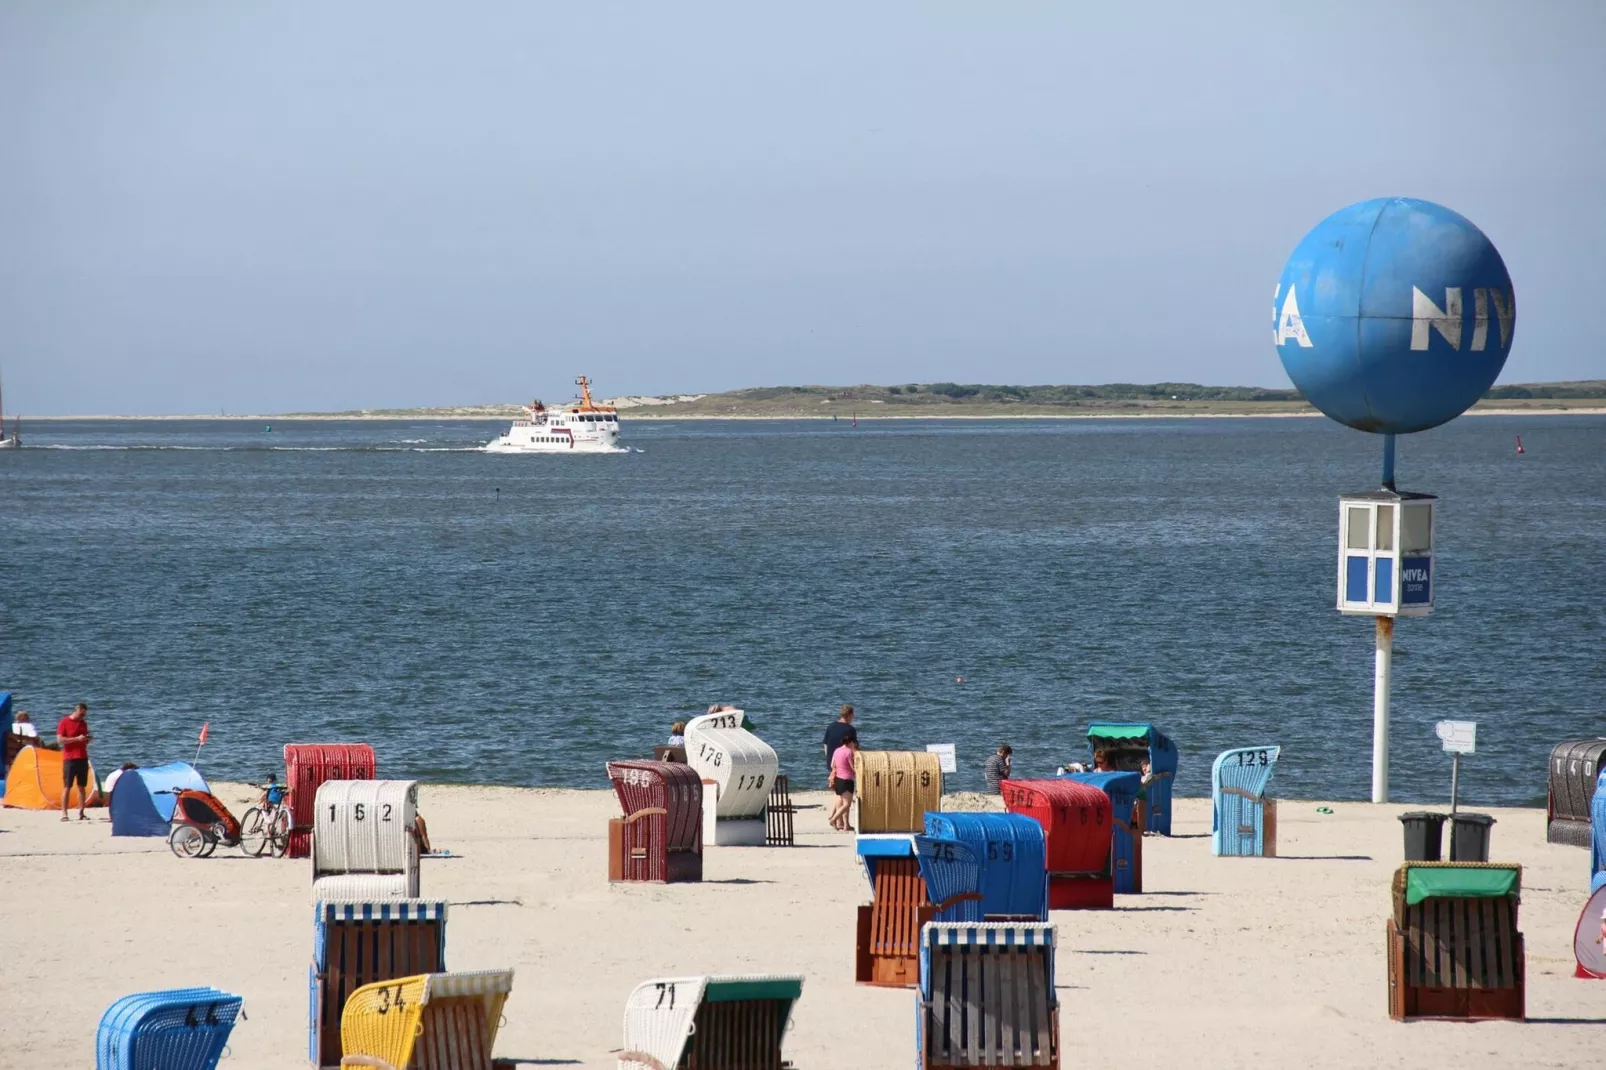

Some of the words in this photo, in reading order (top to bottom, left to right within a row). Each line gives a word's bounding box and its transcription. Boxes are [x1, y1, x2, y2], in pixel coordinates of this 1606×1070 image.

[1402, 568, 1428, 582] NIVEA
[1238, 751, 1268, 767] 129
[1556, 759, 1592, 776] 140
[874, 770, 931, 787] 179
[329, 803, 392, 822] 162
[933, 842, 954, 863] 76
[987, 841, 1012, 861] 59
[377, 984, 406, 1015] 34
[656, 983, 675, 1010] 71
